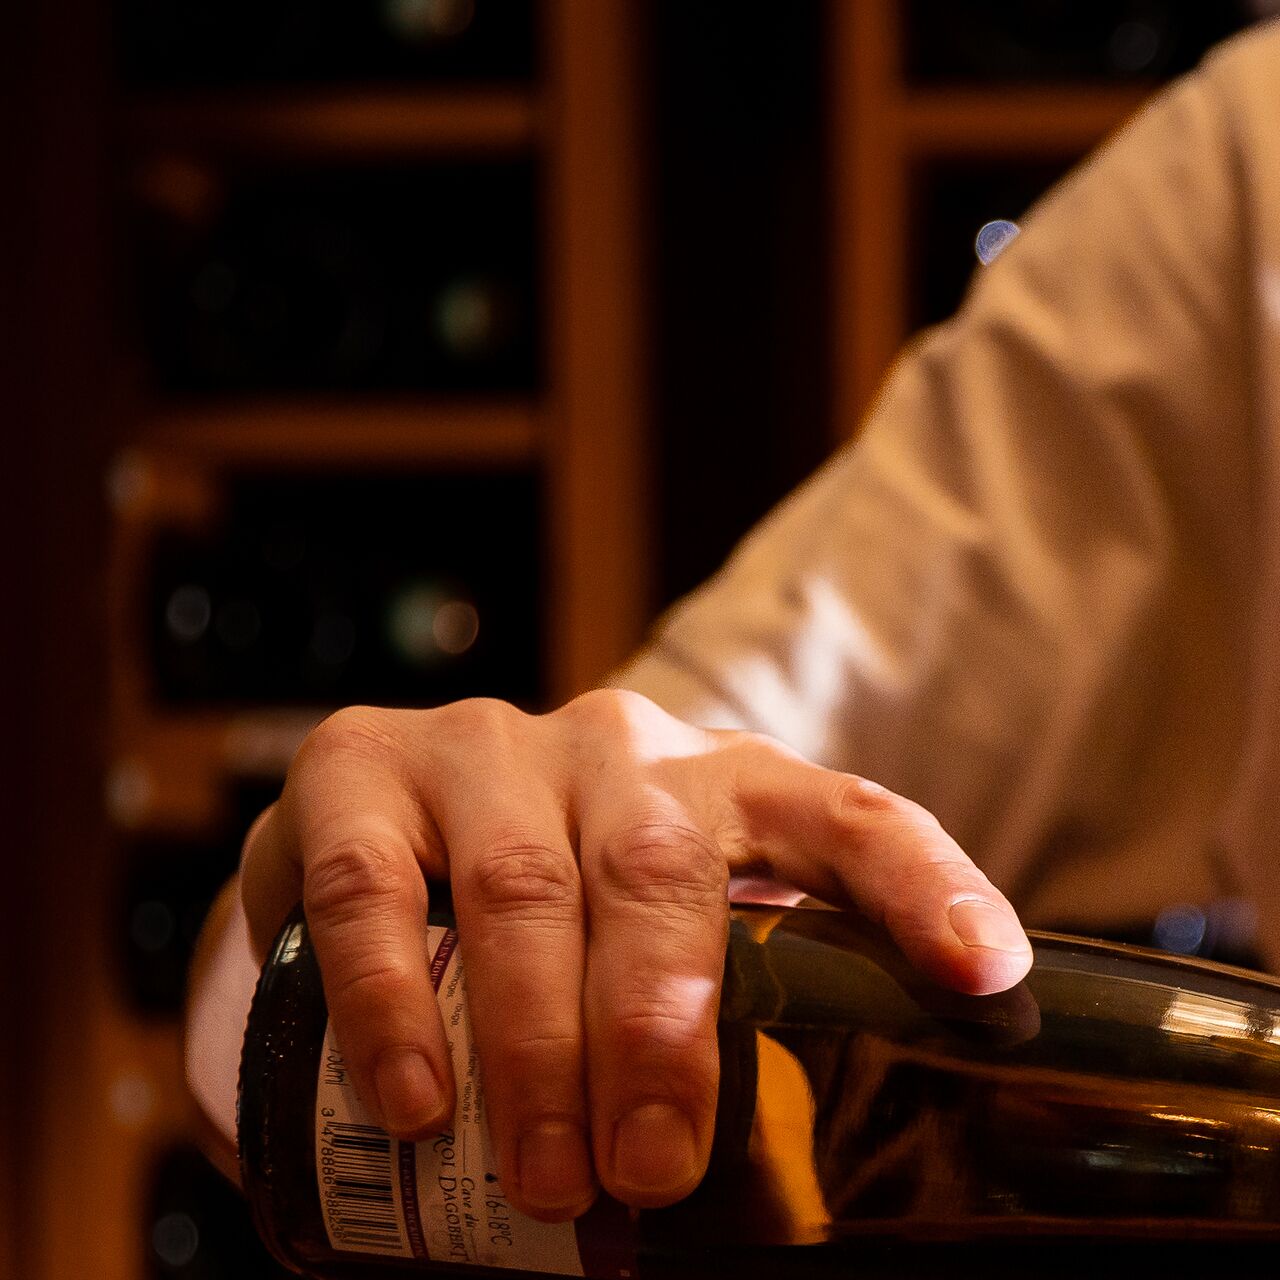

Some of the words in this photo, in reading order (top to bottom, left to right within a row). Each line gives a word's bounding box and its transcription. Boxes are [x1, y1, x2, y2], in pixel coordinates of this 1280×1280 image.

[321, 1108, 335, 1118] 3
[321, 1127, 337, 1185] 478886
[460, 1177, 476, 1208] Cave
[325, 1190, 347, 1240] 988236
[465, 1213, 480, 1228] du
